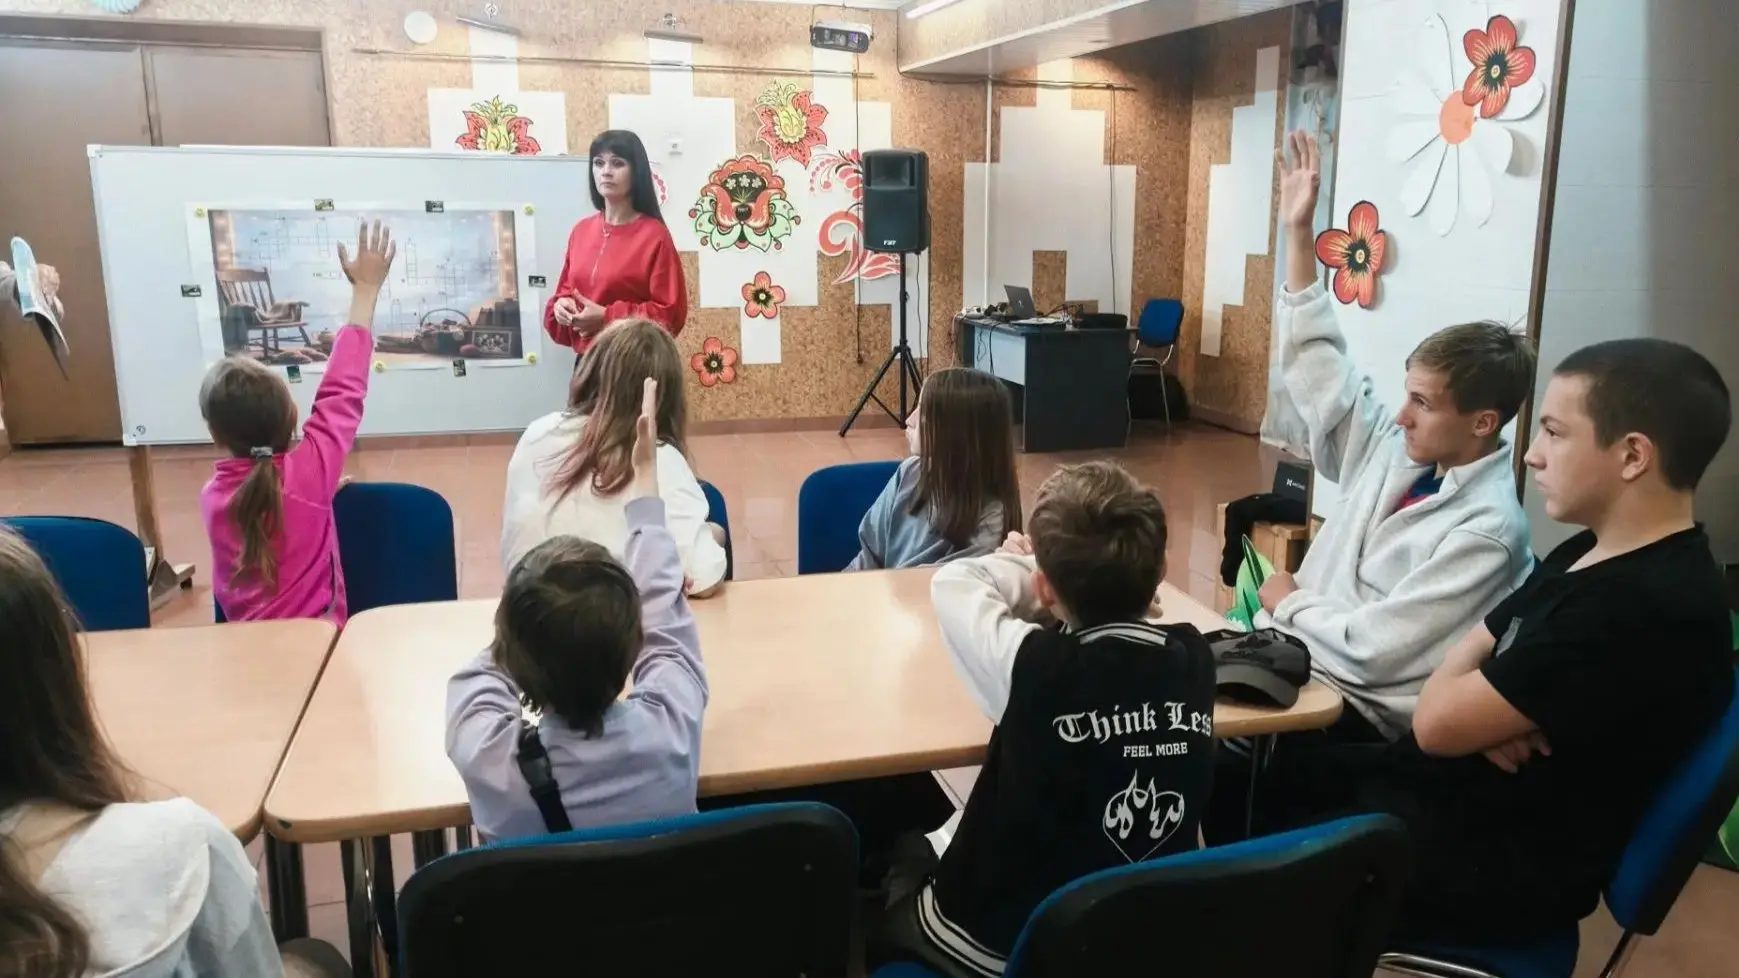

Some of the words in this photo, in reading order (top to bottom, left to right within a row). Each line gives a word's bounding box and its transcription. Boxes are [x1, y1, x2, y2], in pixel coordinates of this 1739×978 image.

[1052, 702, 1158, 744] Think
[1123, 744, 1153, 758] FEEL
[1155, 742, 1188, 756] MORE
